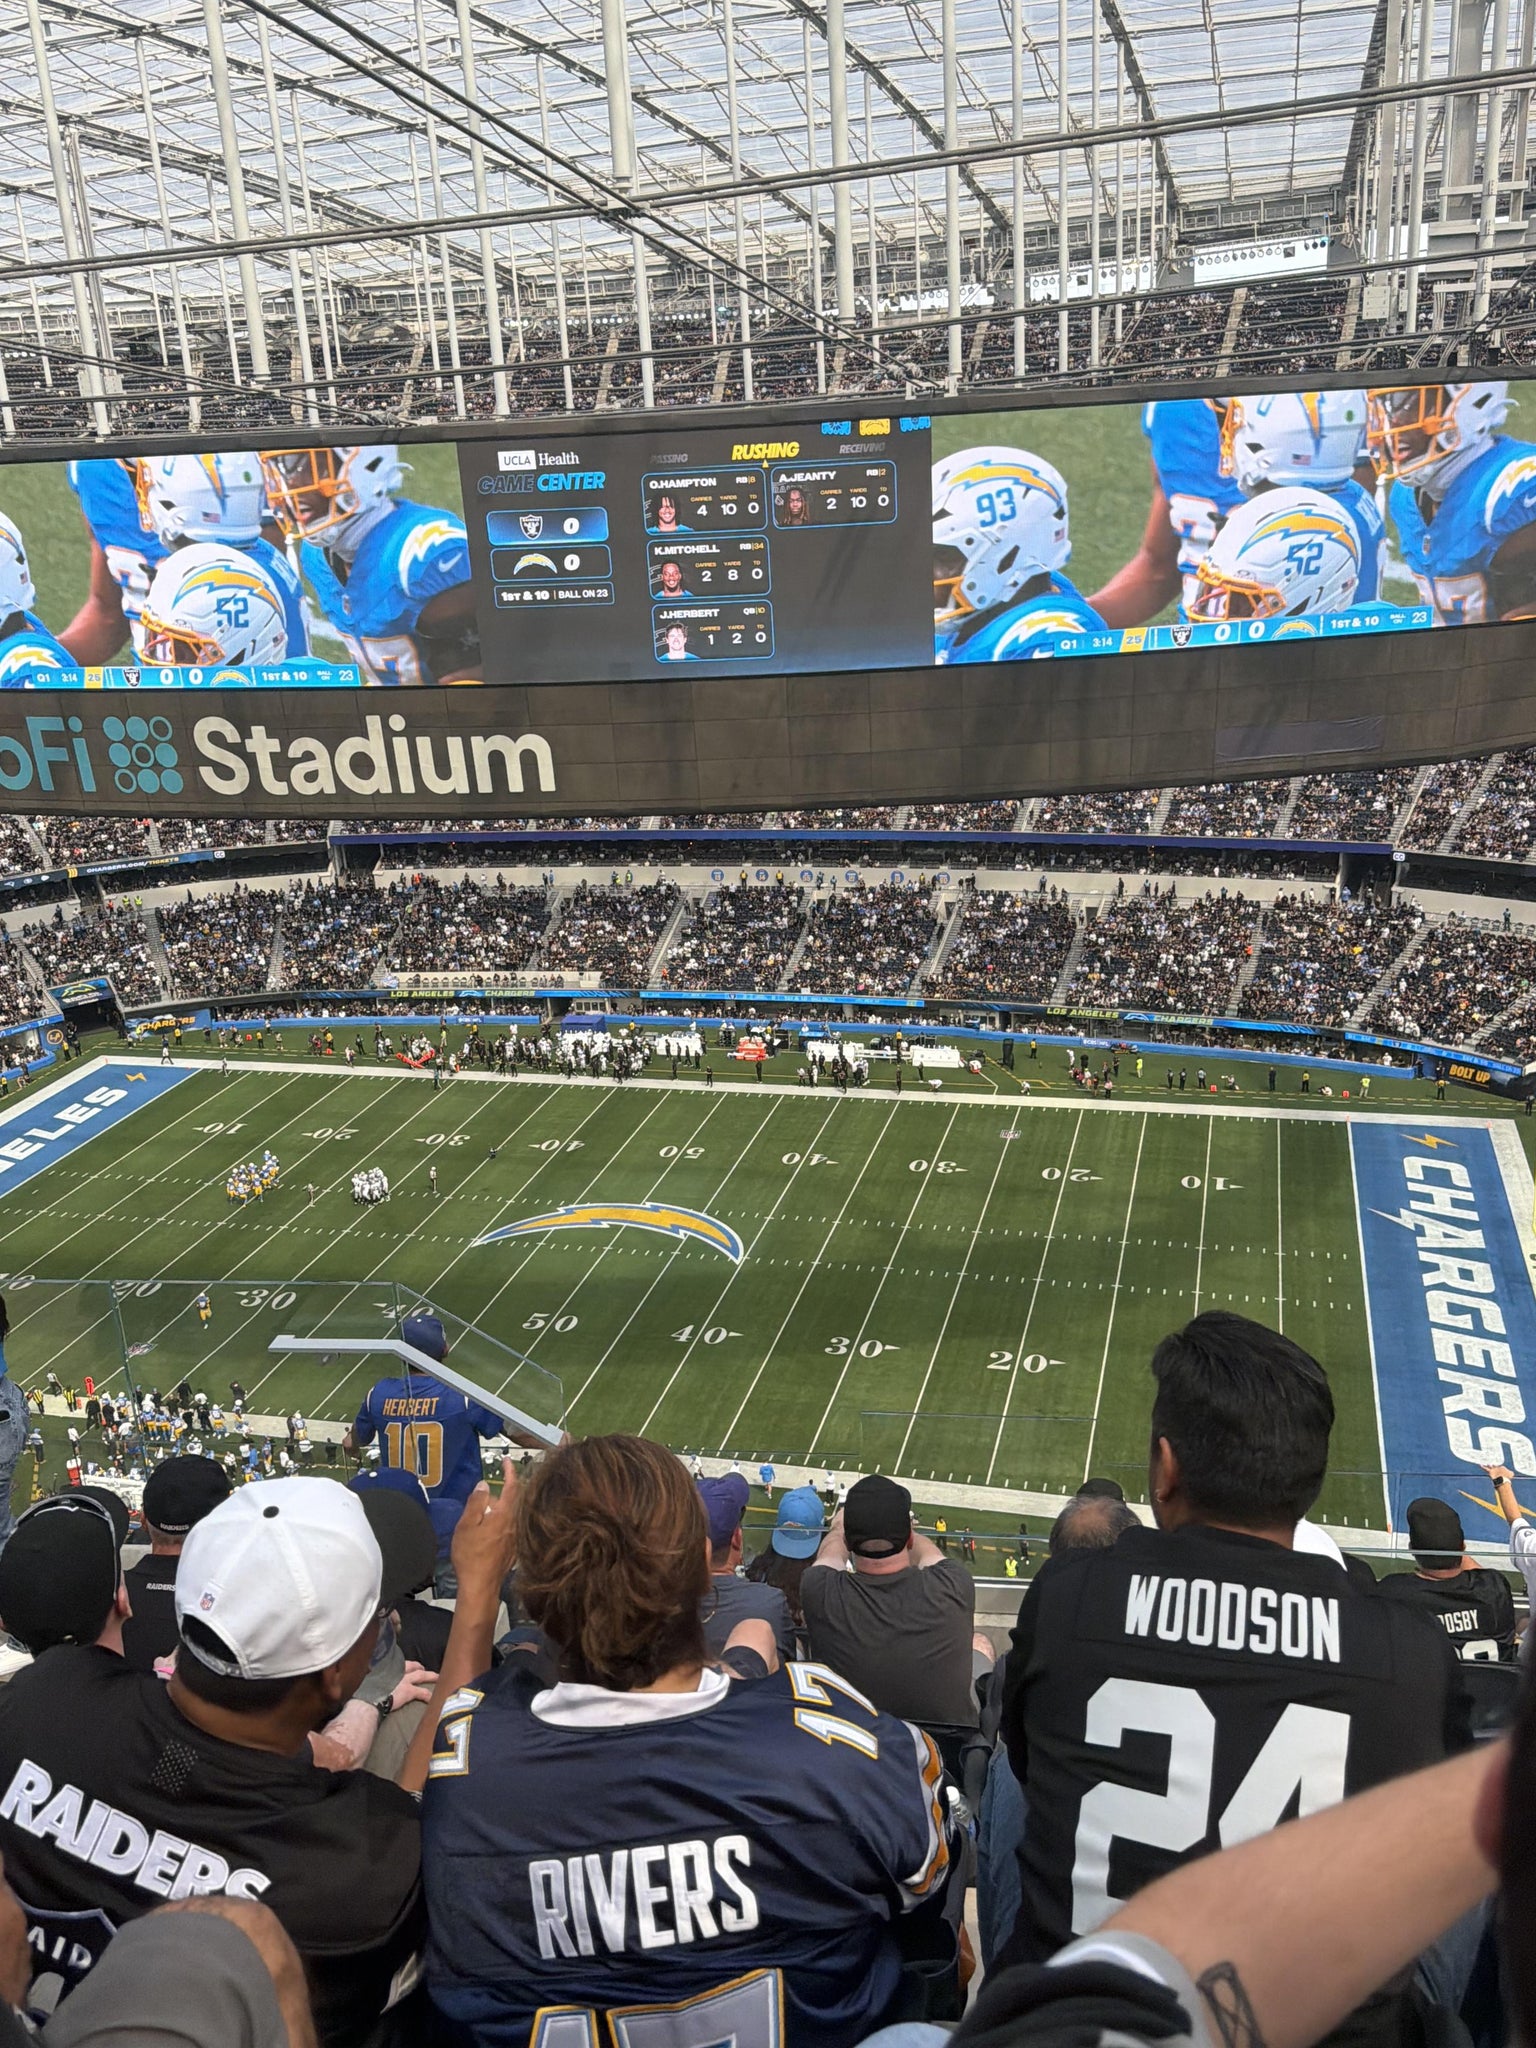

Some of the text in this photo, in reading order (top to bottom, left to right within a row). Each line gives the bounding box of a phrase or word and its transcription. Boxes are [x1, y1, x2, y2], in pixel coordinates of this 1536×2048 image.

[731, 441, 800, 460] RUSHING
[839, 442, 886, 454] RECEIVING
[503, 452, 580, 466] UCLA Health
[477, 471, 606, 495] GAME CENTER
[649, 477, 717, 489] O.HAMPTON
[779, 471, 837, 483] A.JEANTY
[697, 502, 759, 516] 4 10 0
[826, 494, 889, 510] 2 10 0
[976, 487, 1017, 528] 93
[563, 517, 580, 535] 0
[654, 544, 720, 556] K.MITCHELL
[563, 553, 580, 571] 0
[1284, 542, 1324, 576] 52
[702, 568, 763, 582] 2 8 0
[501, 588, 609, 602] 1ST & 10 BALL ON 23
[217, 597, 249, 628] 52
[660, 608, 720, 620] J.HERBERT
[708, 631, 767, 645] 1 2 0
[1060, 612, 1427, 650] Q1 3:14 25 0 0 1ST & 10 23
[36, 668, 354, 685] Q1 3:14 25 0 0 1ST & 10 23
[193, 714, 556, 796] Stadium
[86, 857, 180, 874] CHARGERS.COM/TICKETS
[391, 990, 409, 998] LOS
[411, 990, 455, 998] ANGELES
[1046, 1007, 1214, 1026] LOS ANGELES CHARGERS
[1449, 1063, 1491, 1083] BOLT UP
[202, 1122, 249, 1135] 10
[311, 1127, 359, 1140] 20
[425, 1133, 472, 1147] 30
[538, 1139, 586, 1153] 40
[659, 1145, 706, 1159] 50
[781, 1152, 829, 1167] 40
[909, 1159, 959, 1175] 30
[1041, 1166, 1093, 1182] 20
[1181, 1175, 1232, 1191] 10
[240, 1288, 297, 1310] 30
[522, 1313, 579, 1332] 50
[1368, 1155, 1536, 1477] CHARGERS
[670, 1325, 728, 1345] 40
[824, 1336, 884, 1359] 30
[987, 1350, 1047, 1374] 20
[382, 1397, 439, 1417] HERBERT
[384, 1420, 444, 1488] 10
[145, 1582, 177, 1592] RAIDERS
[1124, 1574, 1341, 1663] WOODSON
[1071, 1677, 1351, 1937] 24
[528, 1835, 760, 1959] RIVERS
